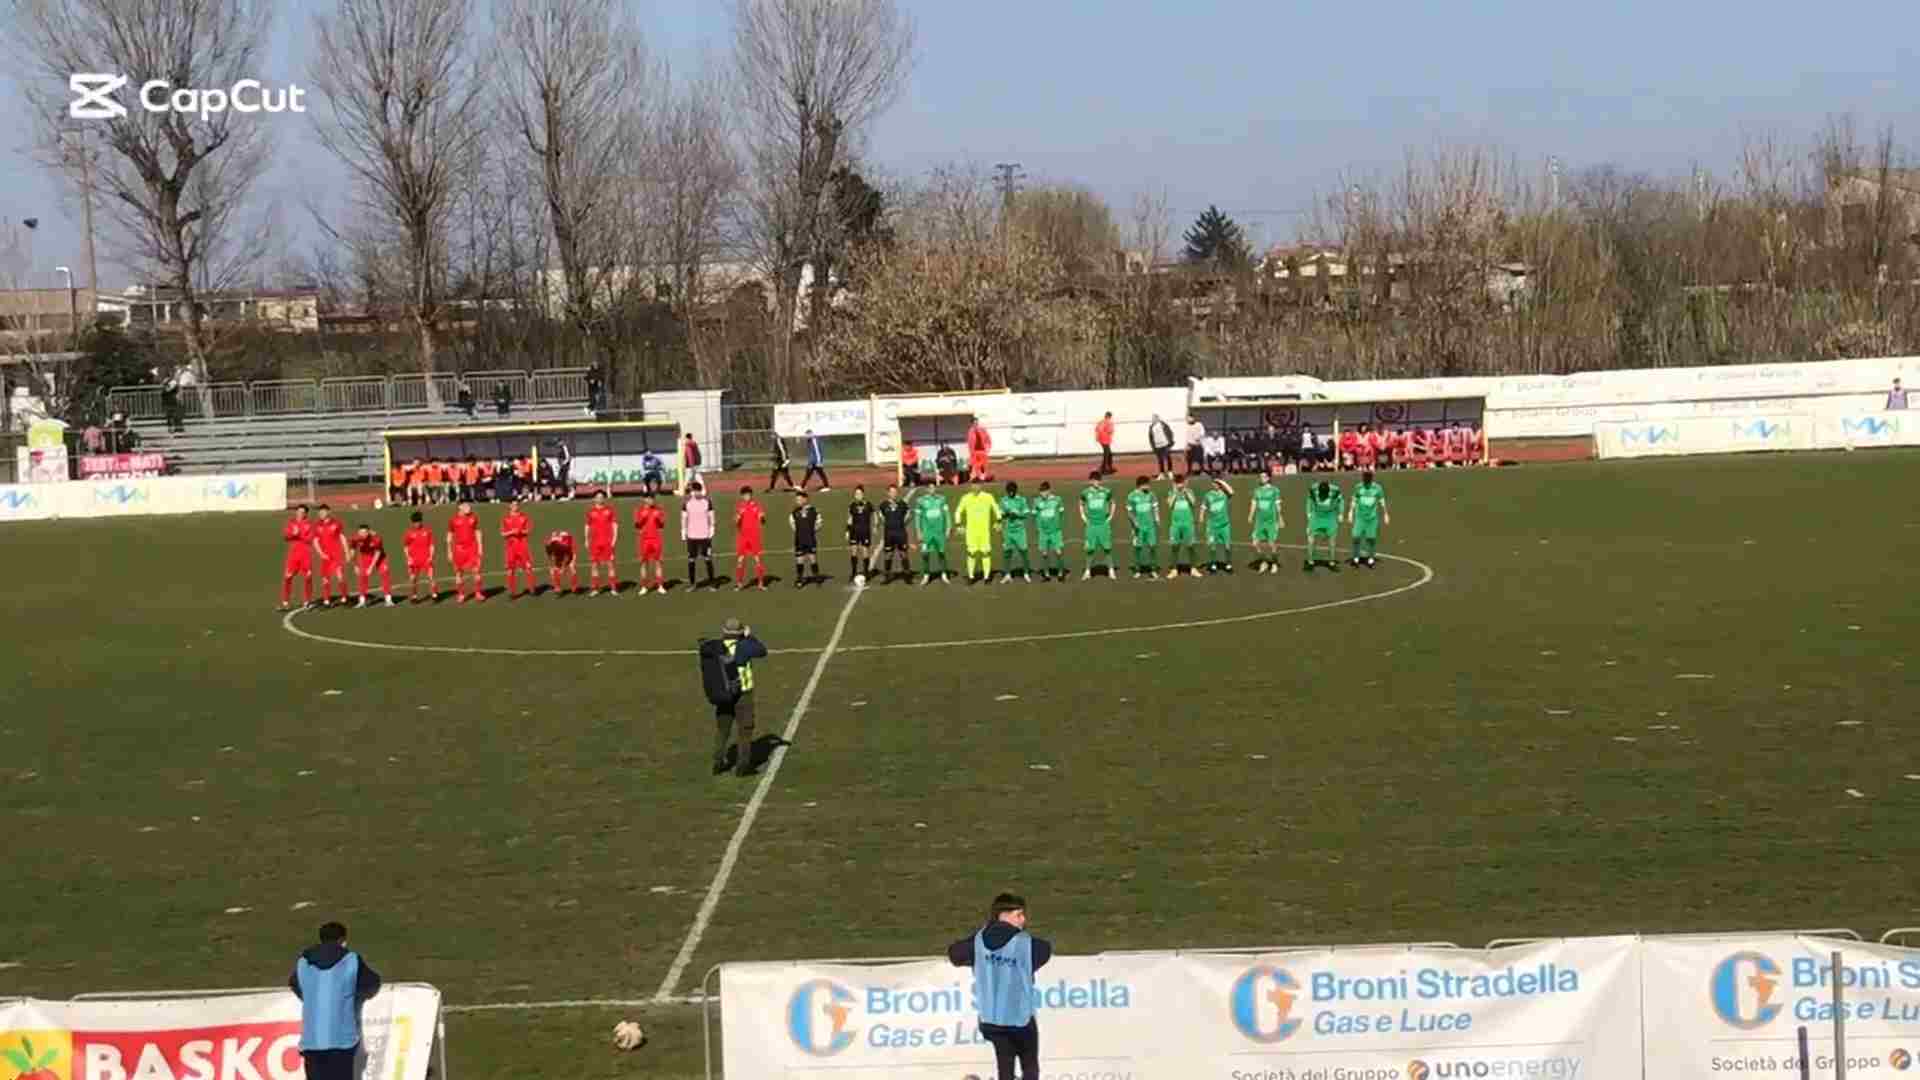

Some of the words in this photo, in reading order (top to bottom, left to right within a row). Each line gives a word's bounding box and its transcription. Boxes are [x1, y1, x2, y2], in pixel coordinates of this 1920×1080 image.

[1311, 970, 1408, 1001] Broni
[1417, 964, 1579, 999] Stradella
[1793, 958, 1890, 988] Broni
[866, 986, 961, 1015] Broni
[1857, 1001, 1875, 1020] e
[1314, 1011, 1369, 1034] Gas
[1376, 1015, 1393, 1033] e
[1400, 1011, 1473, 1032] Luce
[868, 1023, 924, 1048] Gas
[929, 1026, 947, 1046] e
[1711, 1056, 1776, 1071] Società
[1815, 1056, 1880, 1074] Grppo
